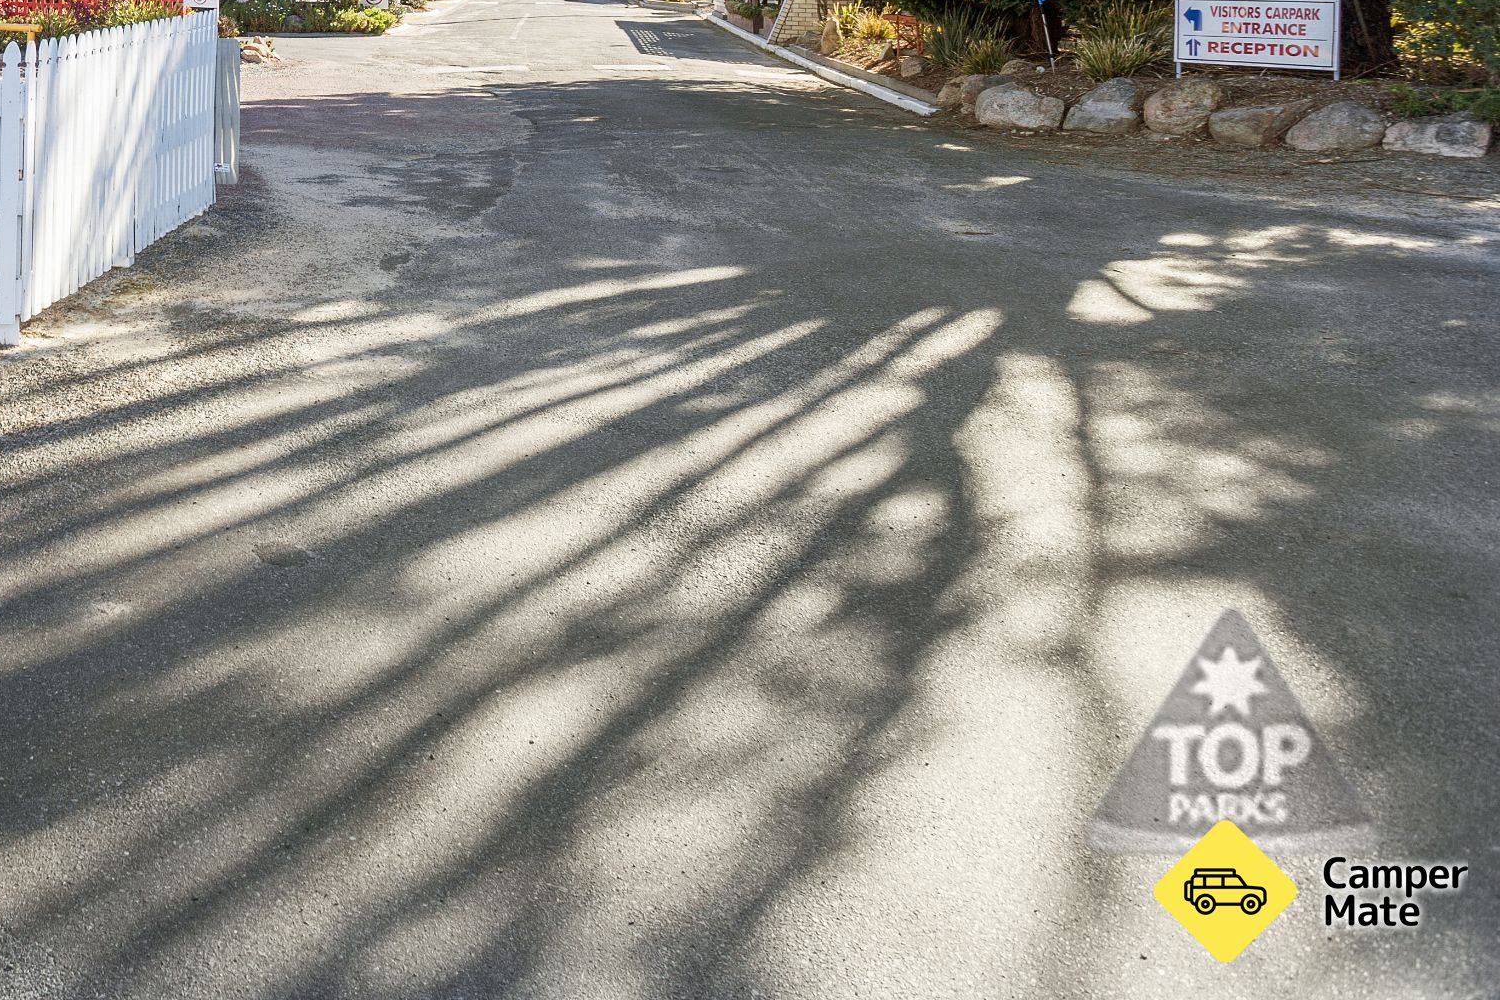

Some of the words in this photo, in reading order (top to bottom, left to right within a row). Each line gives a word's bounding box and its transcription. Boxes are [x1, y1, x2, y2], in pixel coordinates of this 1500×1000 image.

[1210, 5, 1261, 19] VISITORS
[1265, 6, 1321, 21] CARPARK
[1221, 22, 1307, 36] ENTRANCE
[1207, 41, 1320, 58] RECEPTION
